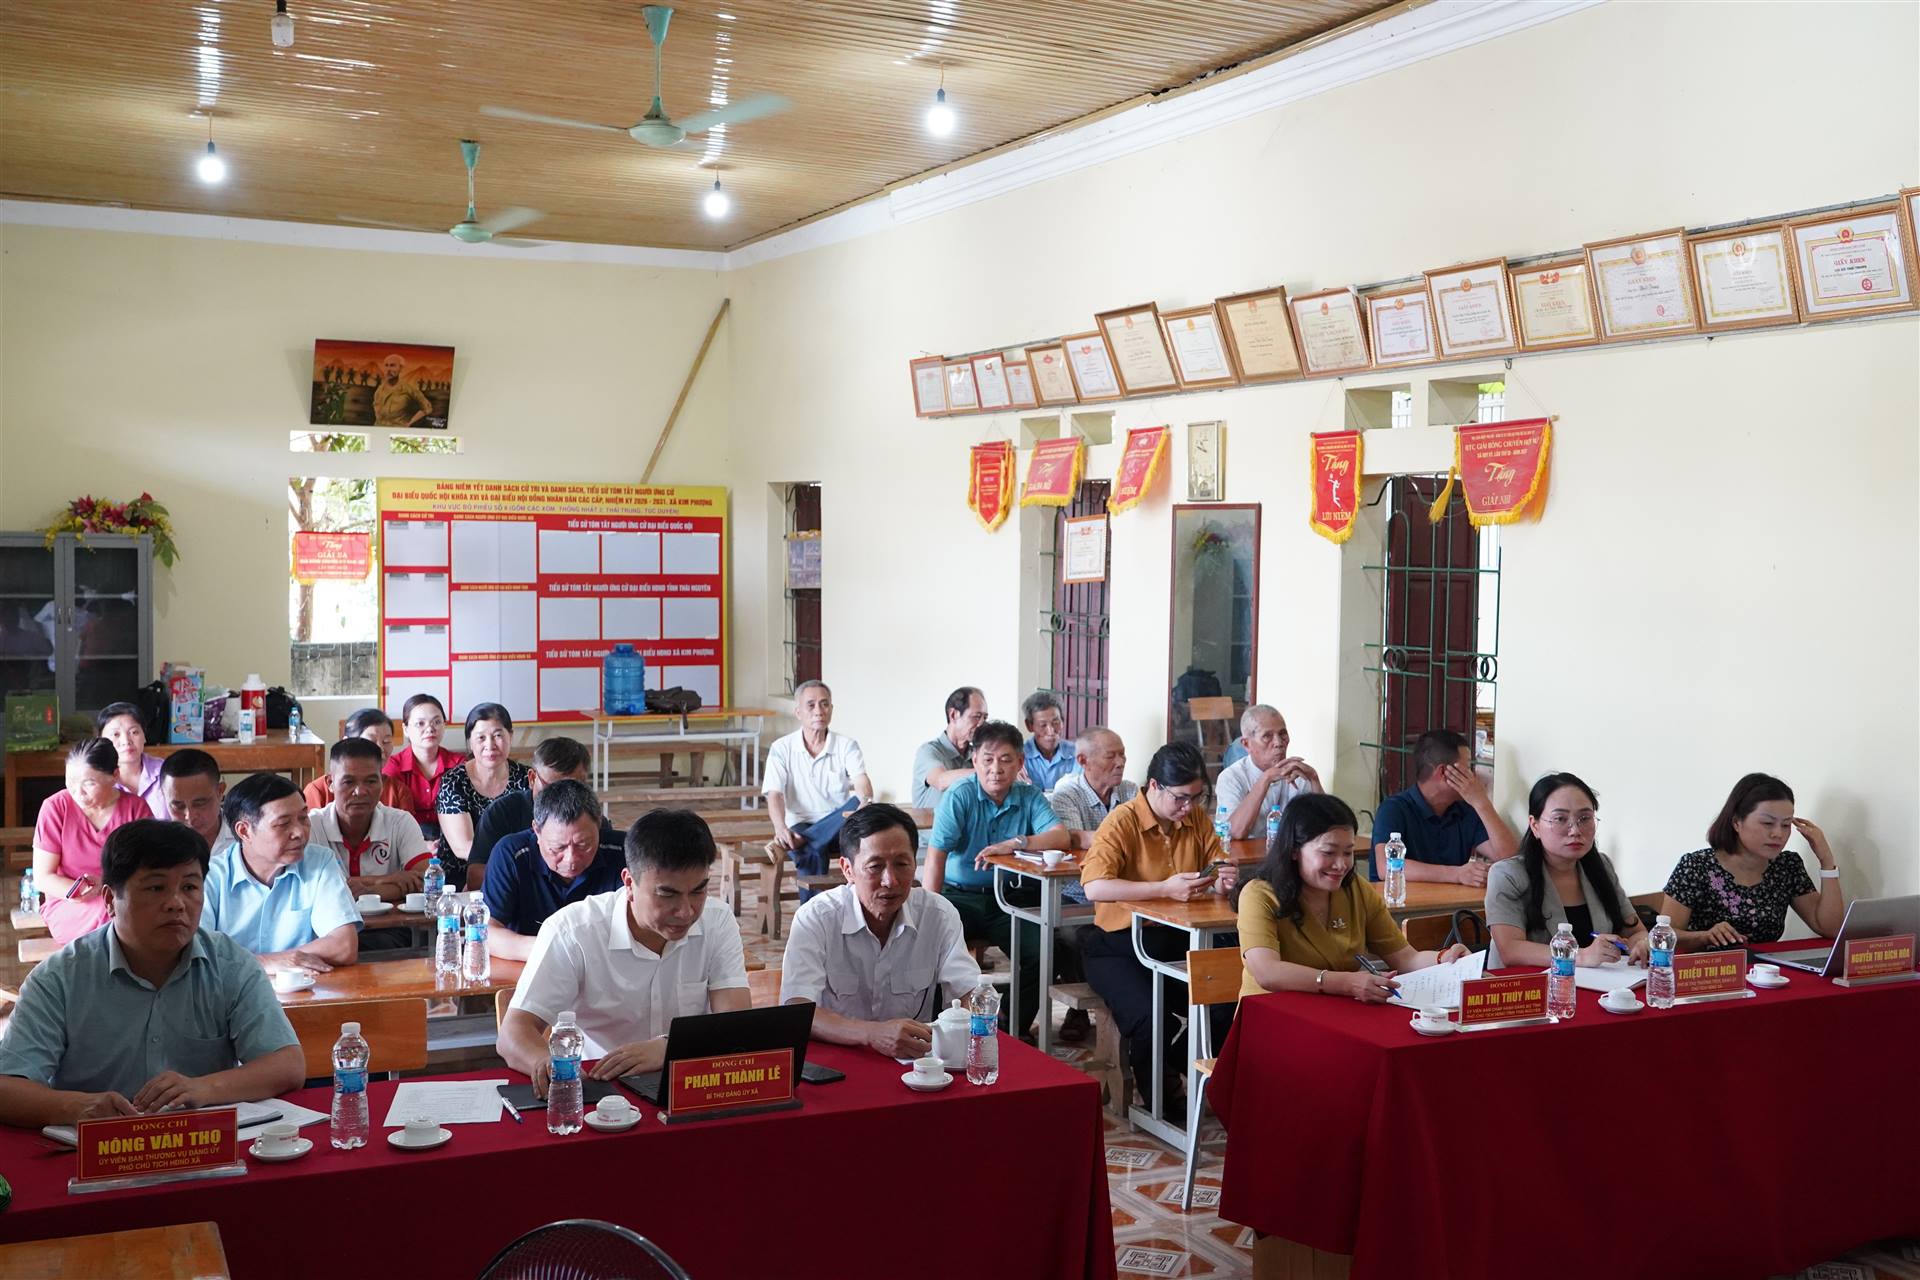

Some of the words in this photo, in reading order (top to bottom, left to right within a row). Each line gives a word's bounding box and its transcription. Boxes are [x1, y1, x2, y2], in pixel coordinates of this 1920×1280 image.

[1678, 966, 1702, 980] TRIỆU
[1720, 964, 1737, 976] NGA
[1467, 994, 1483, 1006] MAI
[1486, 993, 1500, 1006] THỊ
[1525, 989, 1542, 1001] NGA
[739, 1057, 755, 1067] CHÍ
[685, 1073, 720, 1090] PHẠM
[724, 1068, 765, 1085] THÀNH
[768, 1064, 781, 1080] LÊ
[751, 1087, 758, 1095] XÃ
[132, 1121, 164, 1132] ĐỒNG
[167, 1118, 188, 1129] CHÍ
[98, 1136, 145, 1156] NÔNG
[150, 1132, 184, 1150] VĂN
[189, 1129, 222, 1149] THỌ
[110, 1156, 127, 1165] VIÊN
[128, 1155, 144, 1163] BAN
[145, 1150, 176, 1162] THƯỜNG
[177, 1151, 187, 1159] VỤ
[189, 1148, 209, 1157] ĐẢNG
[118, 1162, 134, 1172] PHÓ
[135, 1160, 151, 1170] CHỦ
[152, 1160, 169, 1169] TỊCH
[191, 1156, 201, 1165] XÃ
